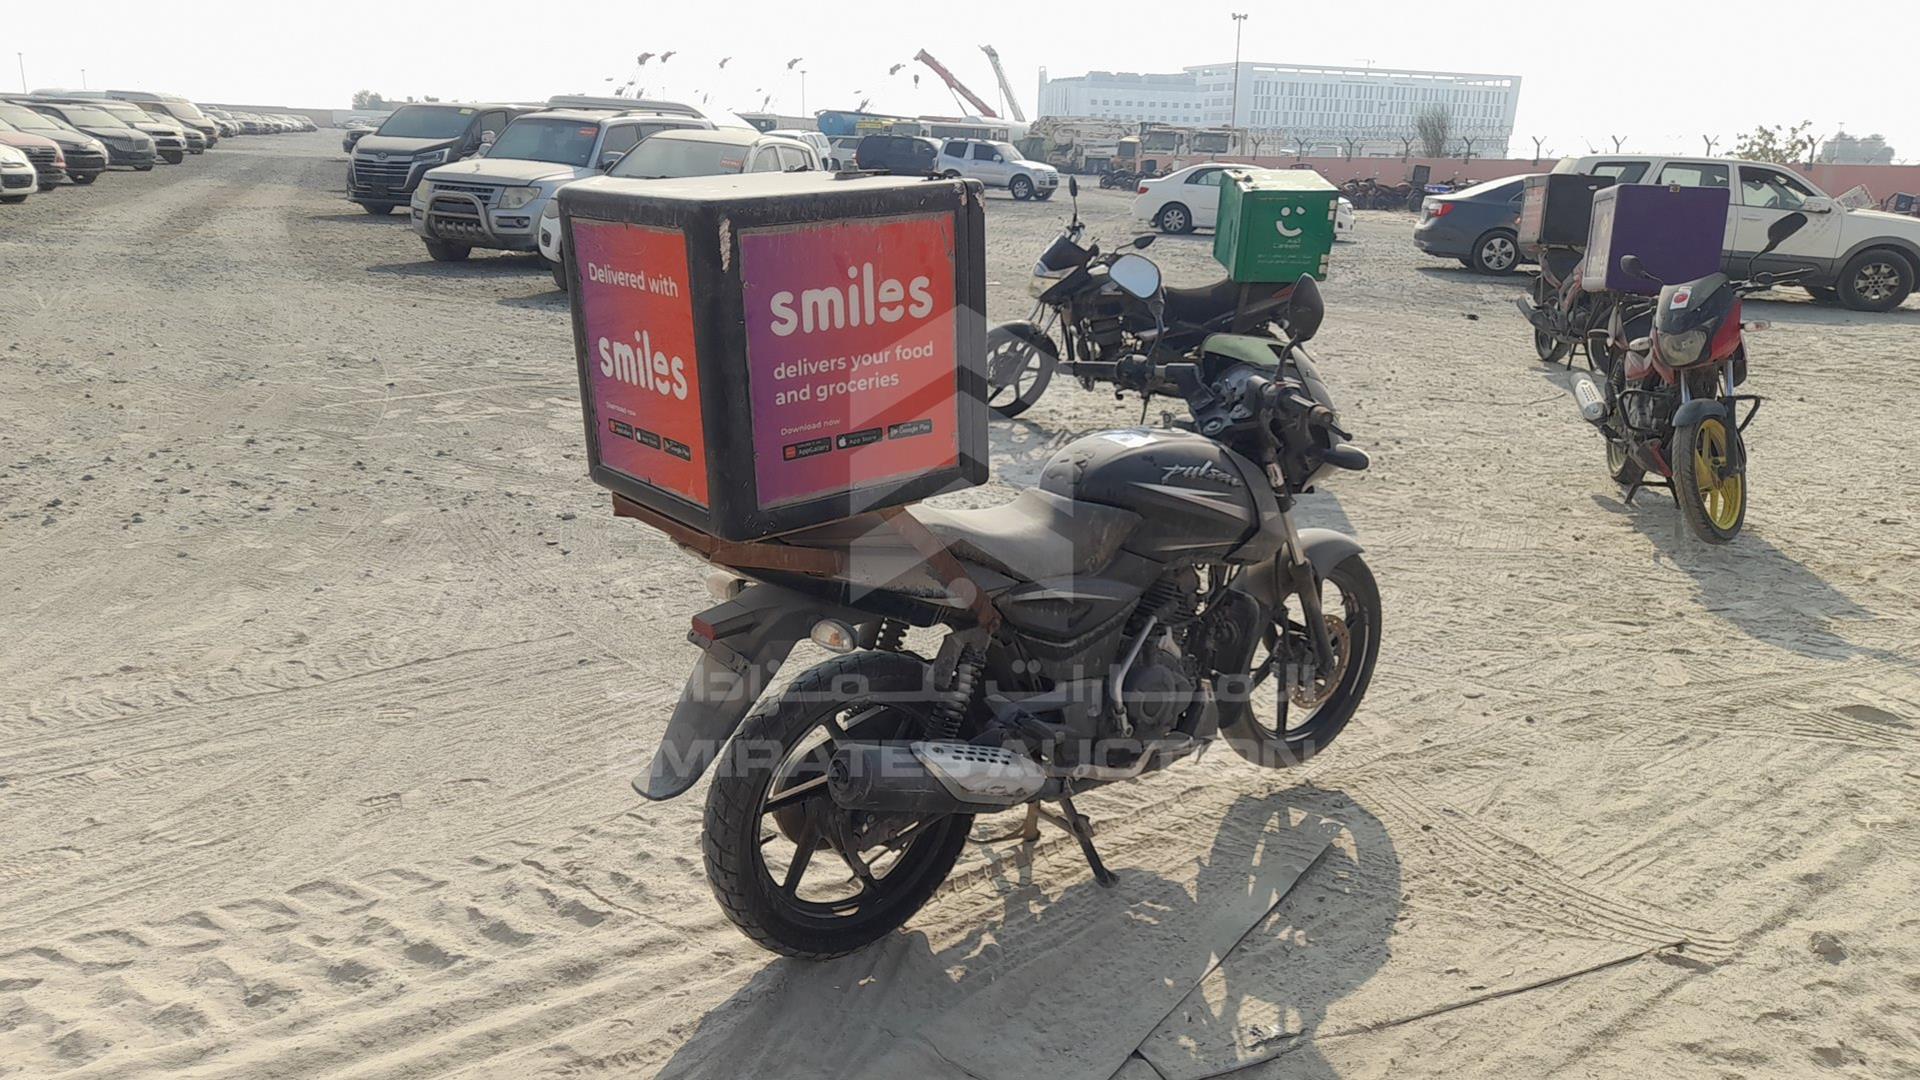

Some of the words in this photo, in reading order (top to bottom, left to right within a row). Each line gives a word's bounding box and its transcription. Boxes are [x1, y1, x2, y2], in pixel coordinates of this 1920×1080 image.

[588, 262, 646, 291] Delivered
[648, 273, 679, 298] with
[770, 262, 934, 337] smiles
[599, 329, 689, 400] smiles
[773, 355, 847, 381] delivers
[851, 348, 891, 372] your
[895, 340, 934, 361] food
[775, 384, 811, 406] and
[816, 372, 900, 402] groceries
[780, 421, 822, 436] Download
[823, 417, 841, 427] now
